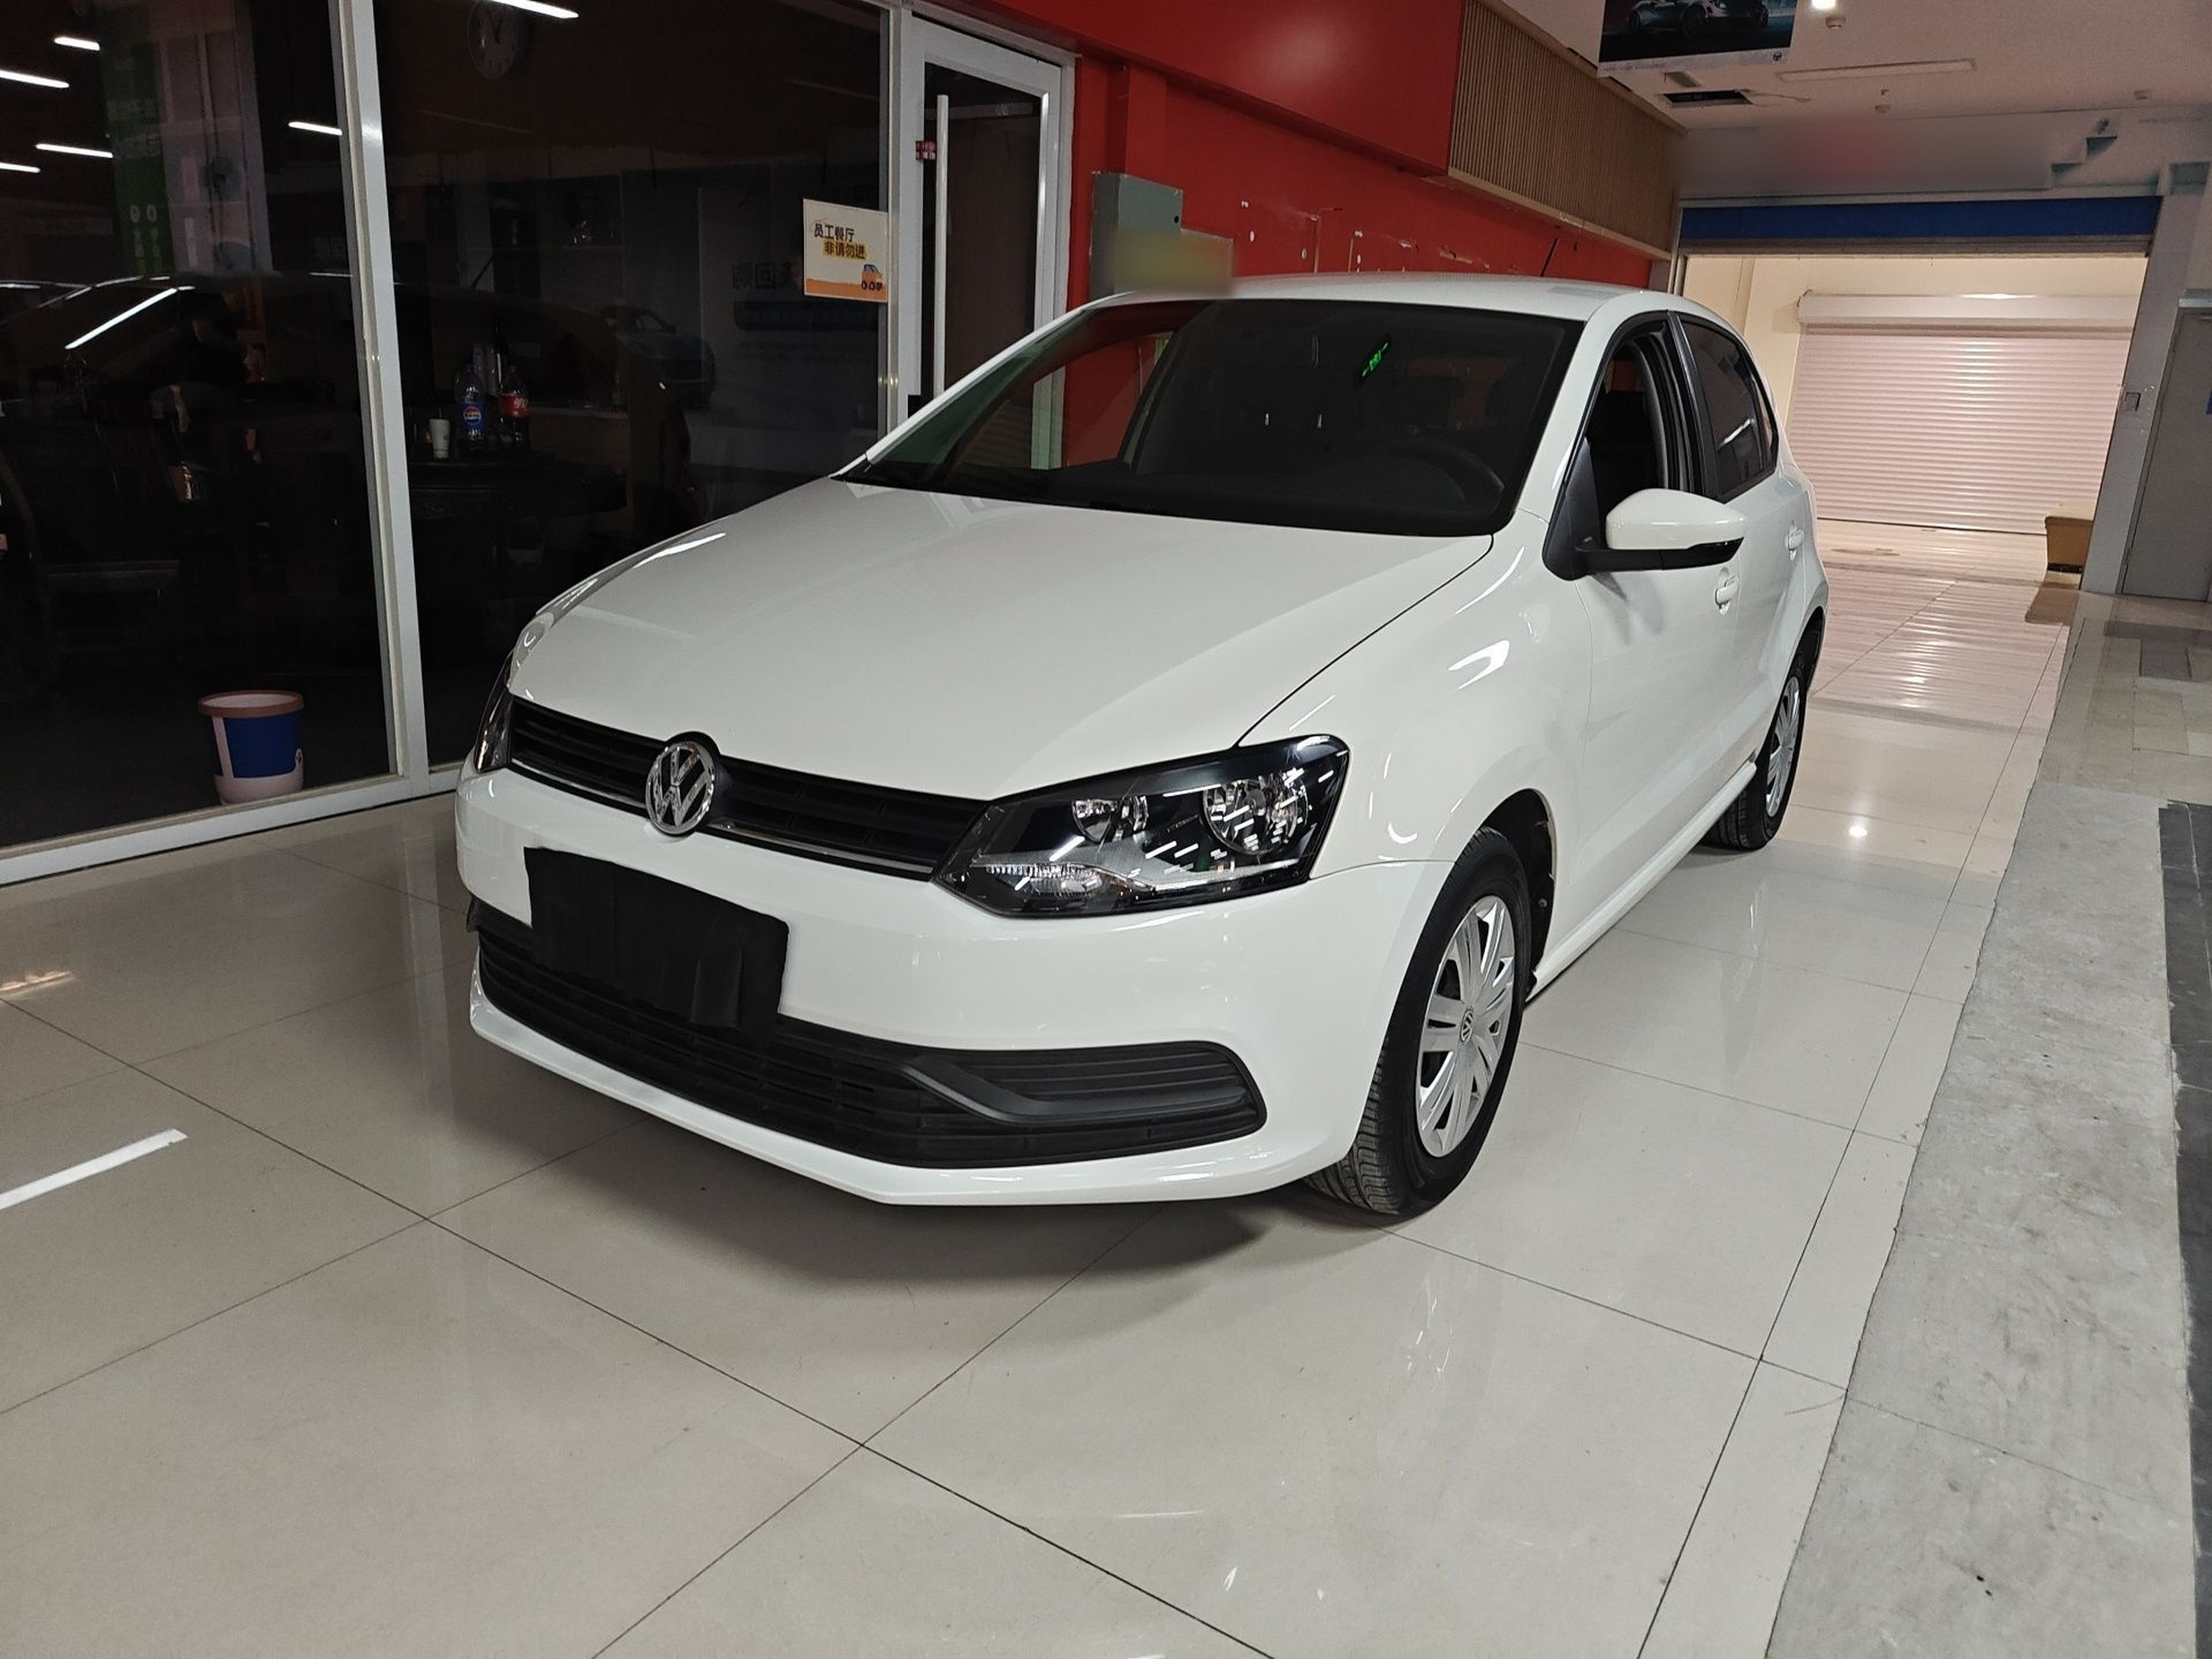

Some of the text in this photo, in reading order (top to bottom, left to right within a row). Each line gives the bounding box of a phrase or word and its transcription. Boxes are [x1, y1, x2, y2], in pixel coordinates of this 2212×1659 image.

[814, 223, 855, 242] 员工餐厅
[824, 241, 866, 259] 非请勿进
